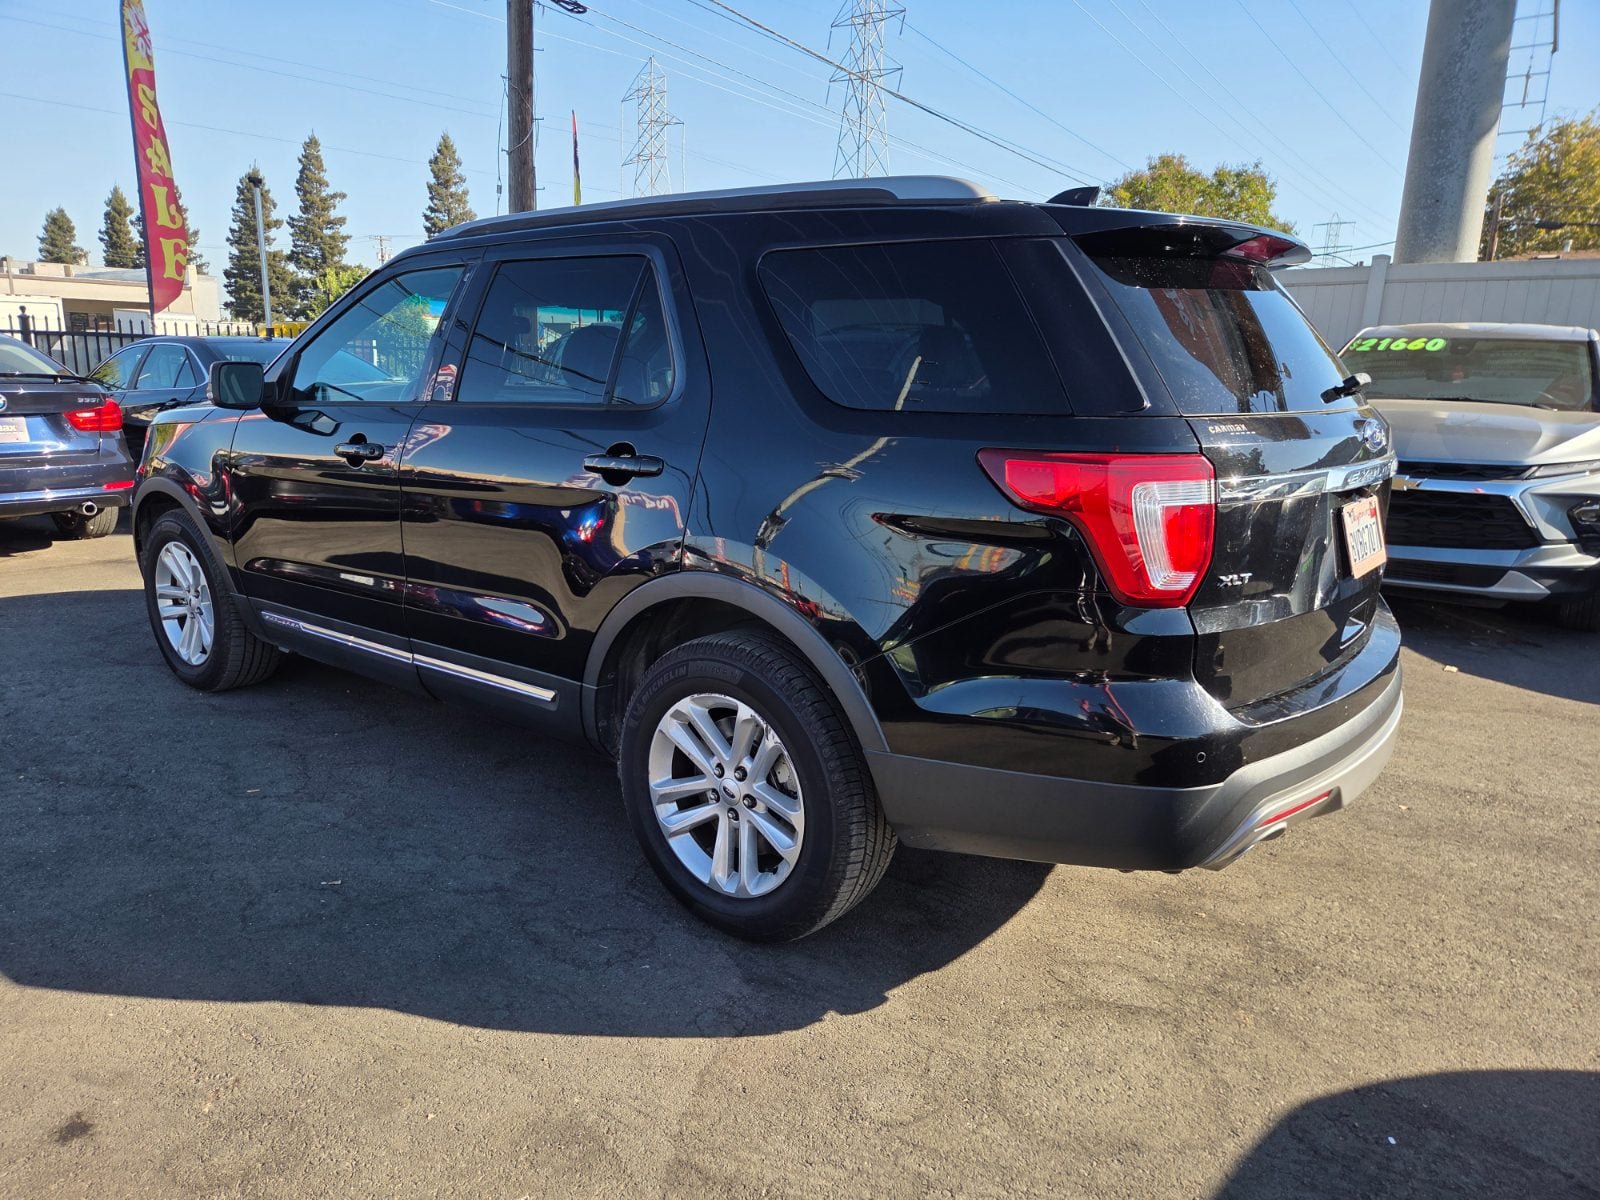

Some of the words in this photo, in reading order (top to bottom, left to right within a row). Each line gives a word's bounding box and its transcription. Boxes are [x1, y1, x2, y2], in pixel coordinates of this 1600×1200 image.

[137, 83, 188, 281] SALE
[1349, 337, 1447, 351] $21660
[1216, 572, 1253, 587] XLT
[640, 662, 688, 705] MICHELIN
